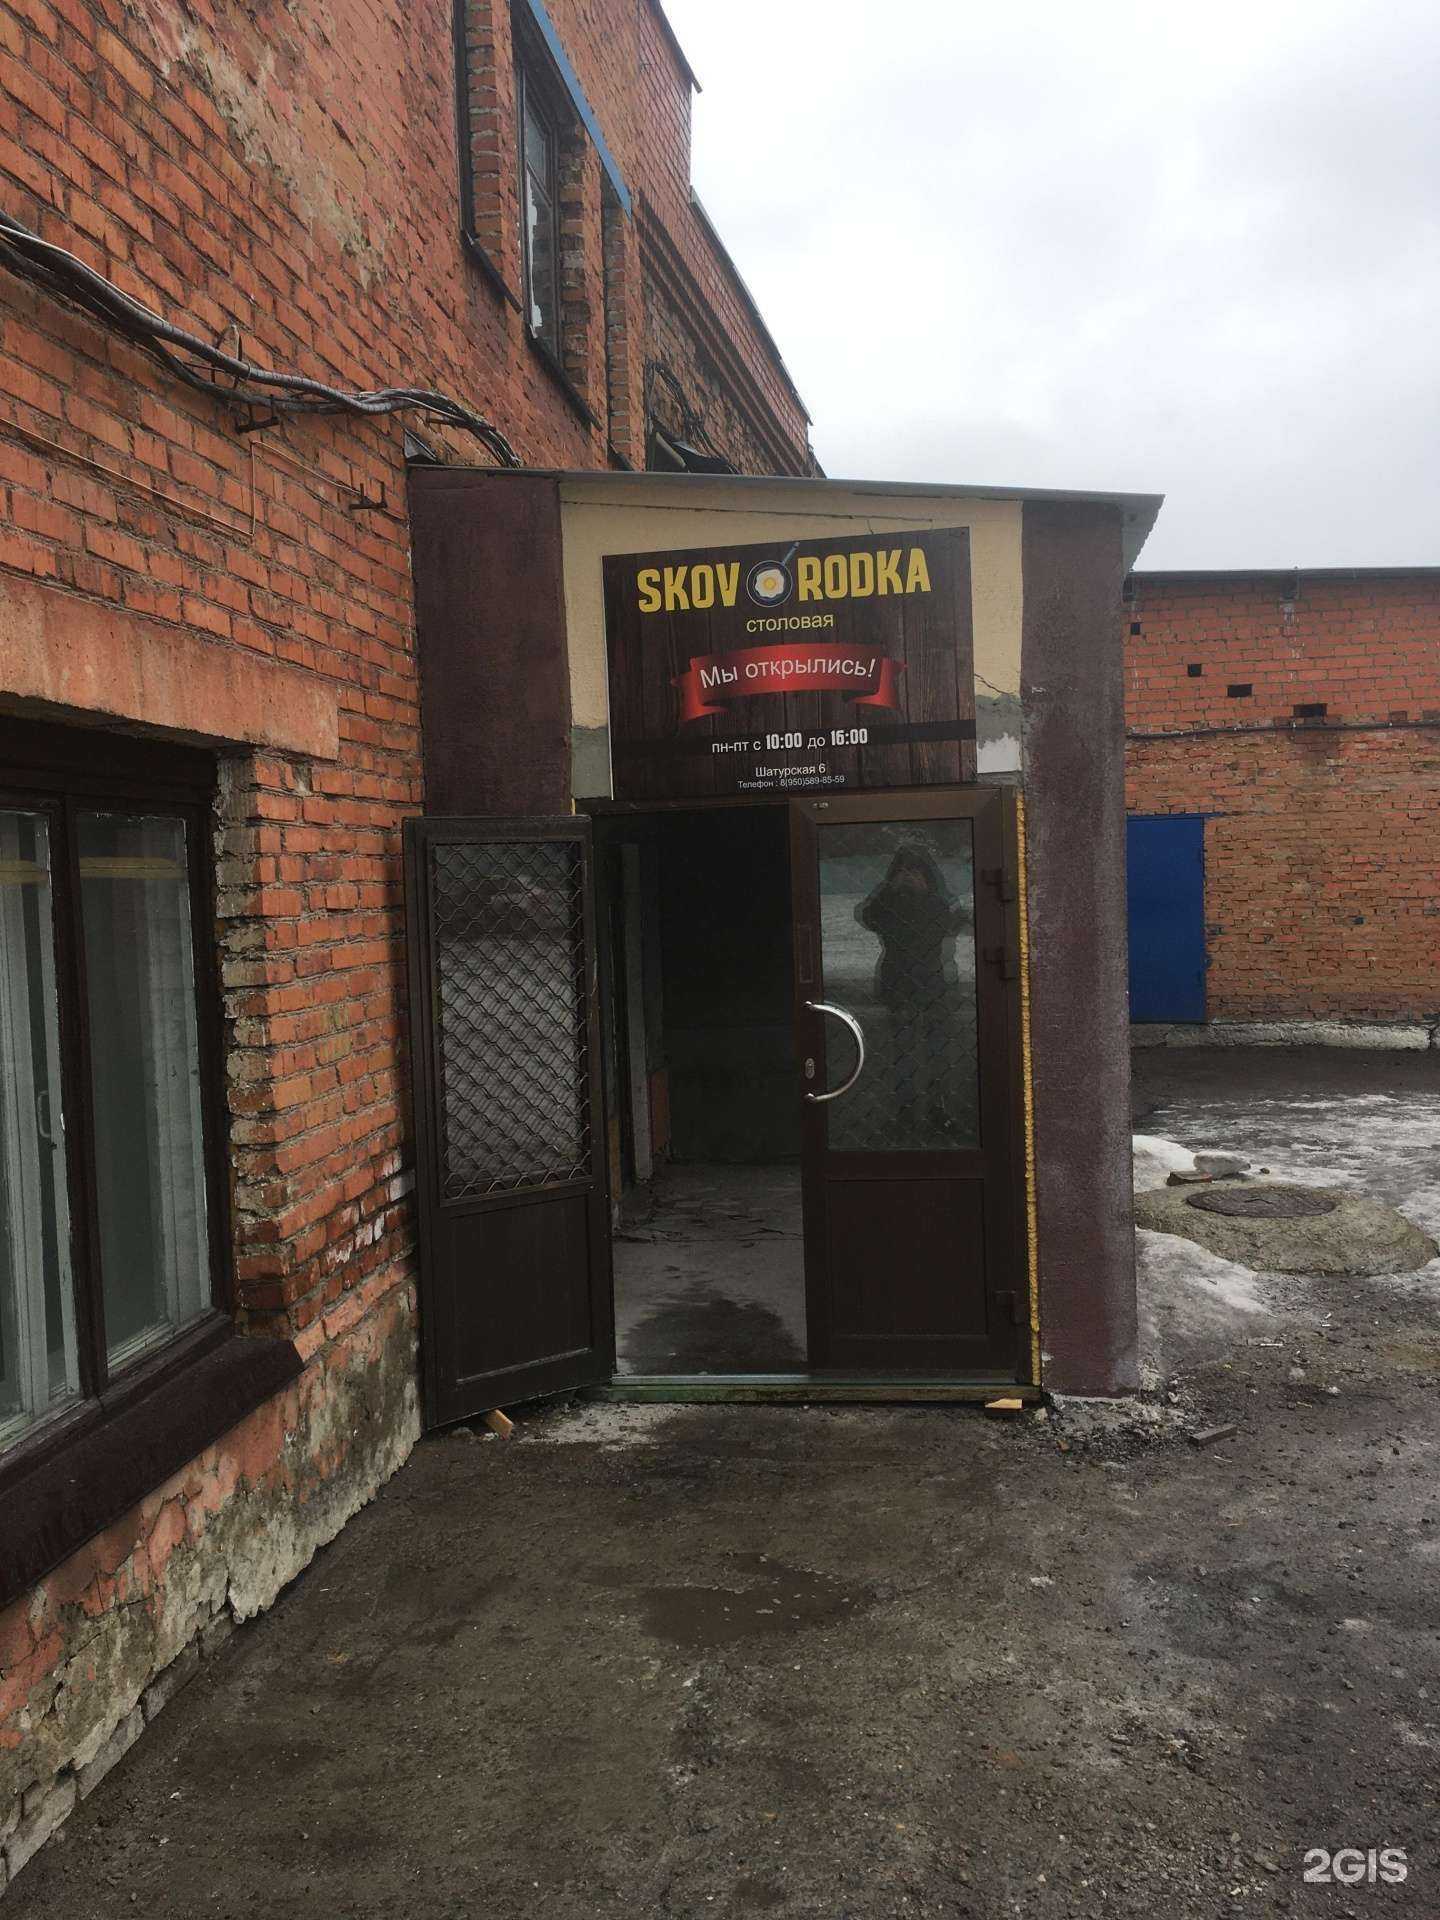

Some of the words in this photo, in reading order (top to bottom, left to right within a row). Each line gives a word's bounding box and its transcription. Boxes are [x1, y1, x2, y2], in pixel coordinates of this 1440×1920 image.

[637, 562, 741, 613] SKOV
[797, 548, 932, 601] RODKA
[746, 613, 834, 633] столовая
[700, 665, 738, 688] Мы
[745, 658, 876, 680] открылись!
[711, 741, 750, 753] пн-пт
[753, 740, 762, 751] с
[766, 732, 802, 750] 10:00
[807, 737, 826, 750] до
[830, 728, 868, 746] 16:00
[755, 764, 816, 779] Шатурская
[818, 763, 826, 774] 6
